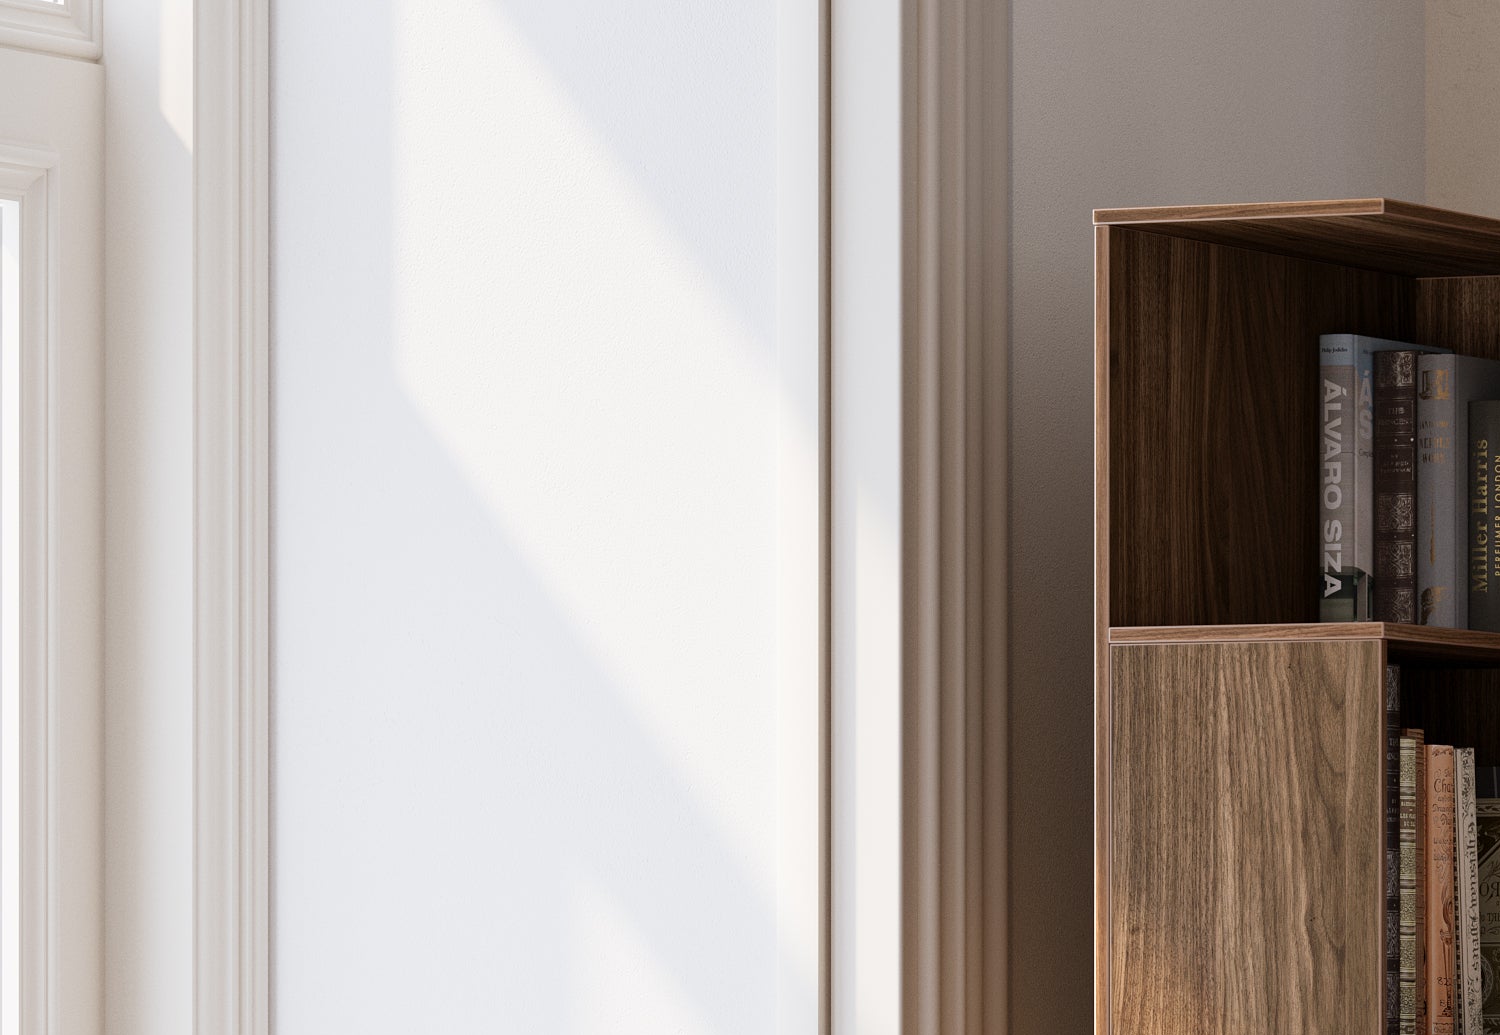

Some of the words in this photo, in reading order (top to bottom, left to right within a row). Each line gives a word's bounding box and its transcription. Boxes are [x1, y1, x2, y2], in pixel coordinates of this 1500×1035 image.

[1323, 378, 1347, 511] ÁLVARO
[1472, 438, 1488, 515] Harris
[1323, 519, 1344, 598] SIZA
[1472, 524, 1488, 593] Miller
